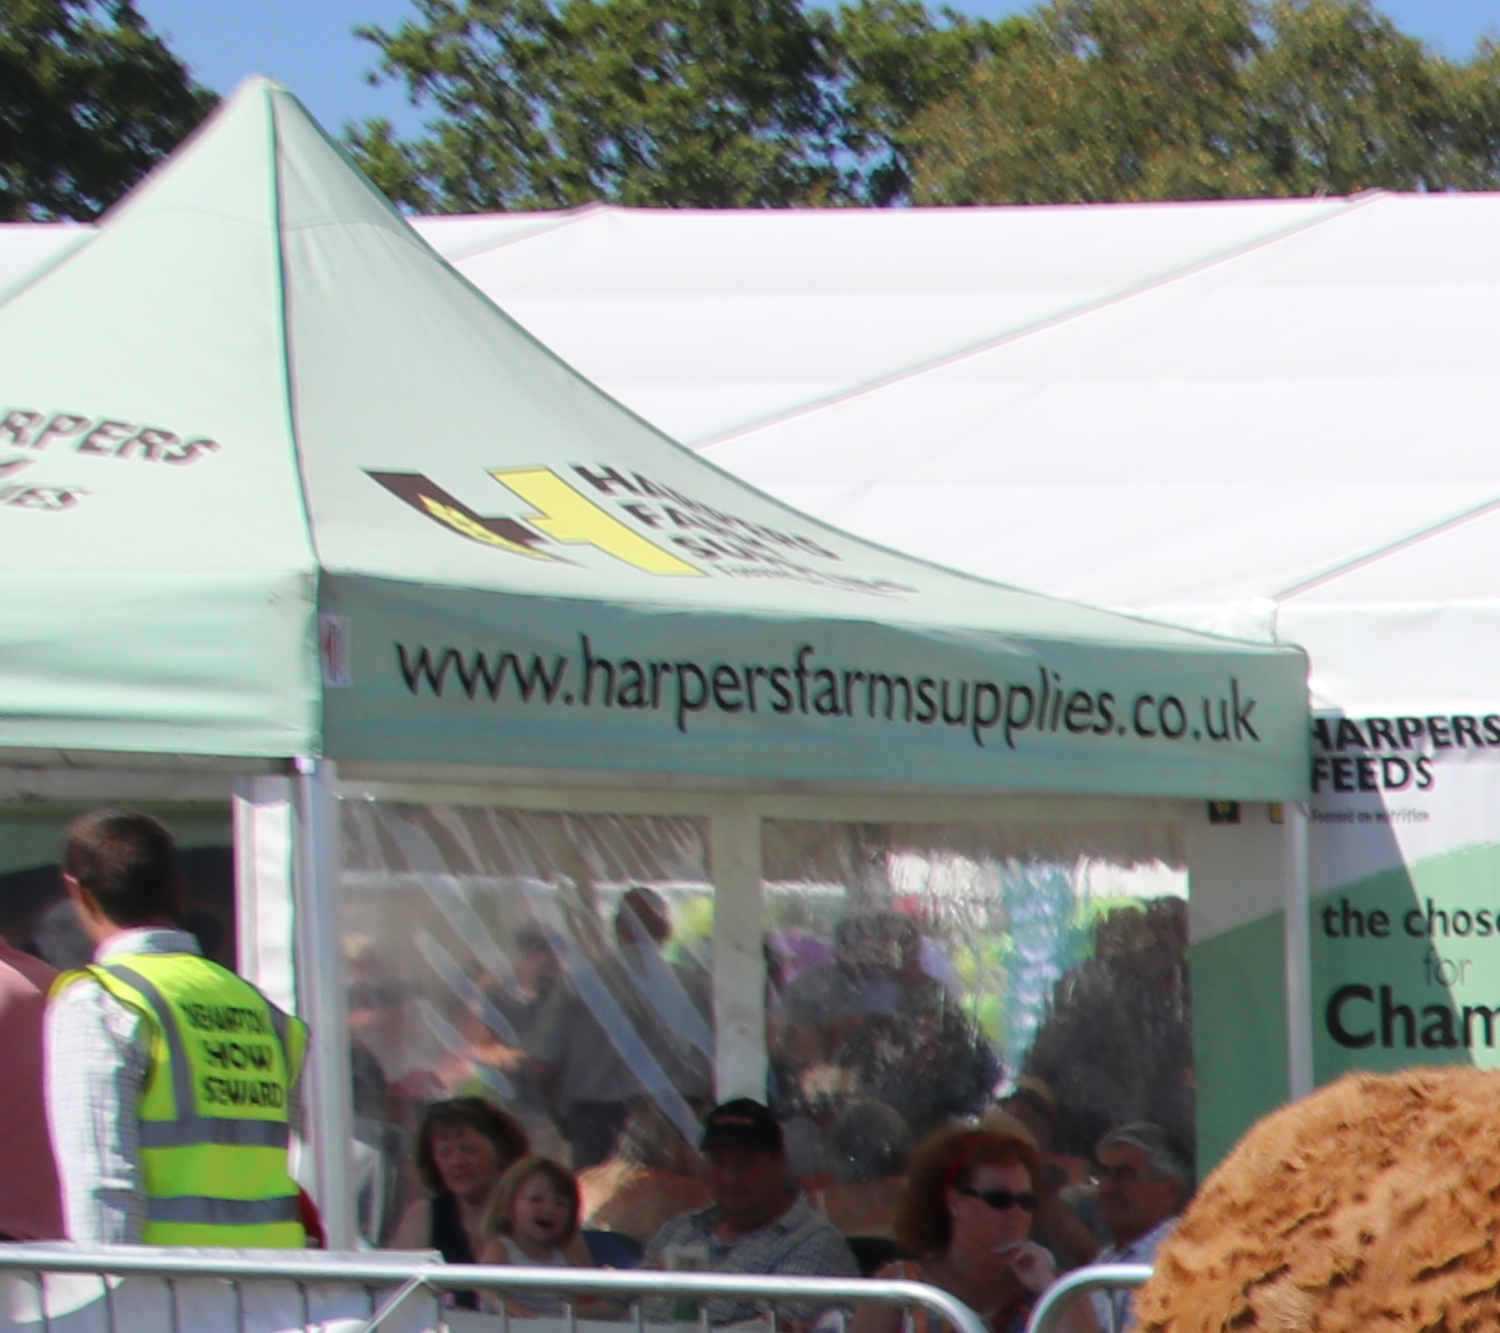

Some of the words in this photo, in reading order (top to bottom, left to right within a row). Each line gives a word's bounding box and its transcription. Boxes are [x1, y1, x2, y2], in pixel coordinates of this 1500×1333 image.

[395, 631, 1261, 750] www.harpersfarmsupplies.co.uk
[1312, 757, 1434, 792] FEEDS
[1322, 898, 1391, 938] the
[1423, 949, 1471, 987] for
